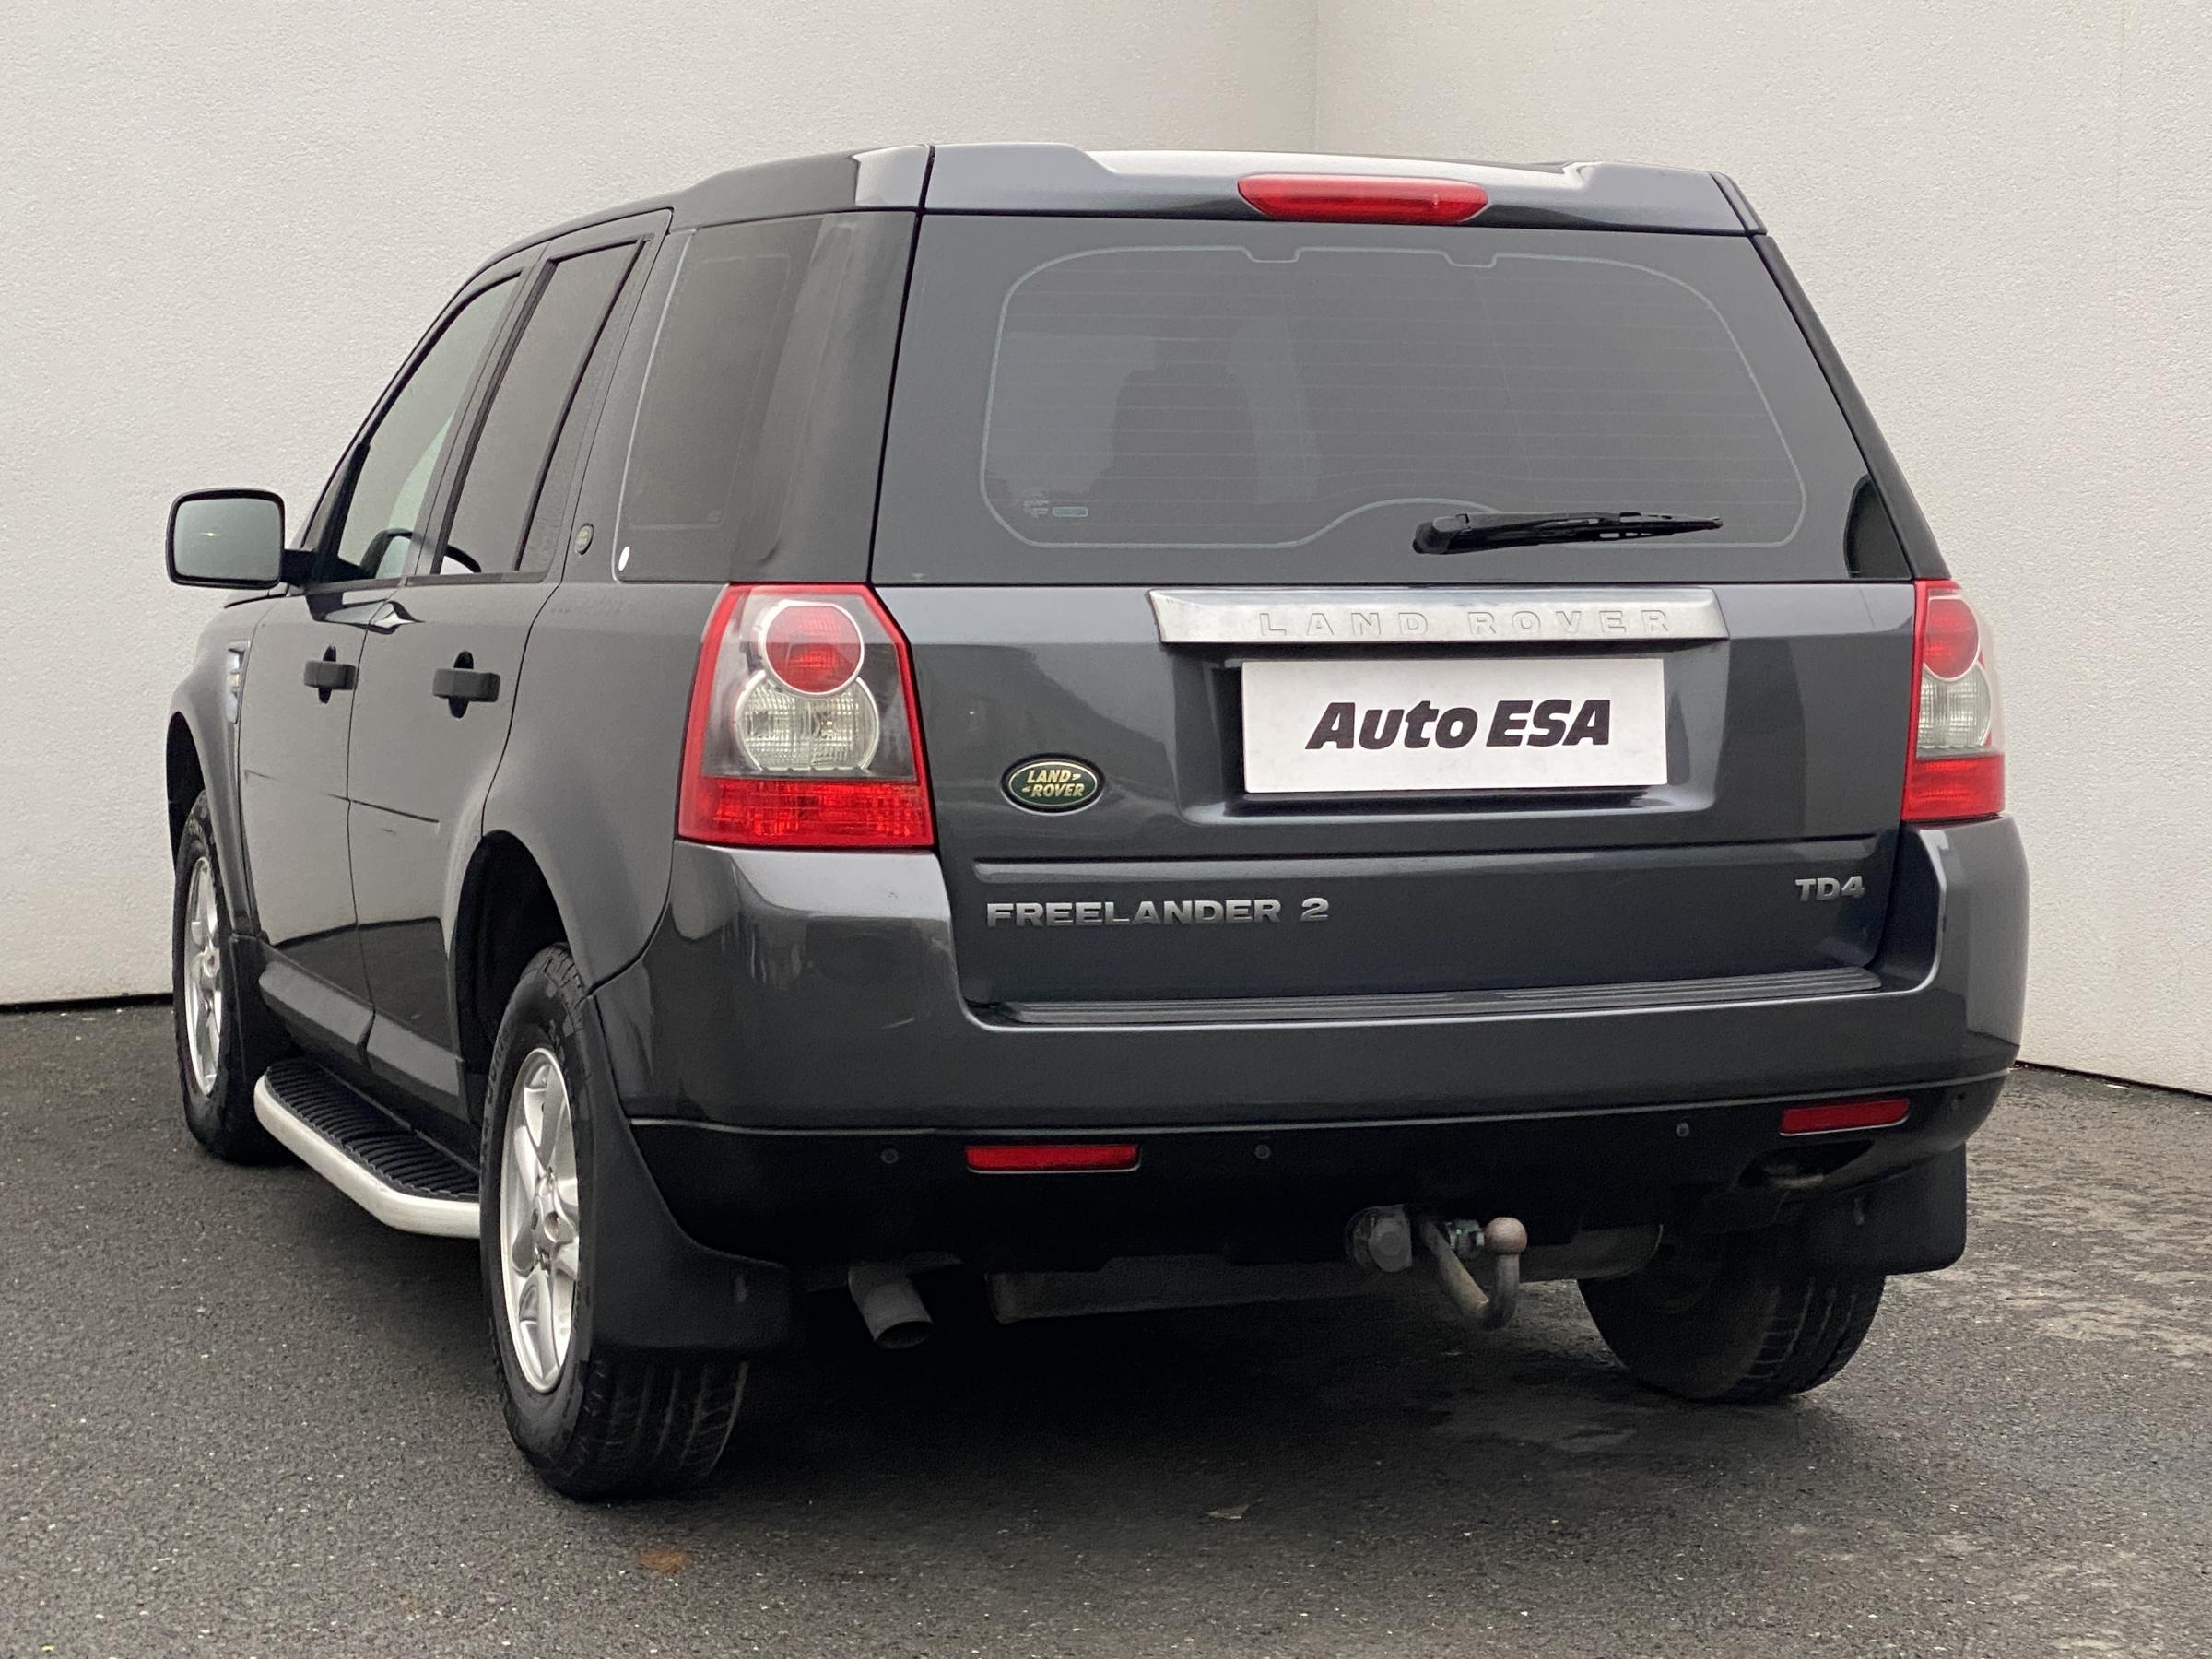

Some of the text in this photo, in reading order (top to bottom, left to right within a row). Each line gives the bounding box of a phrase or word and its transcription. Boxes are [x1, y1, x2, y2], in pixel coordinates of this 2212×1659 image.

[1259, 609, 1669, 637] LAND ROVER
[1304, 699, 1611, 750] Auto ESA
[1027, 769, 1072, 784] LAND
[1031, 783, 1086, 798] ROVER
[1794, 876, 1865, 902] TD4
[986, 897, 1330, 927] FREELANDER 2
